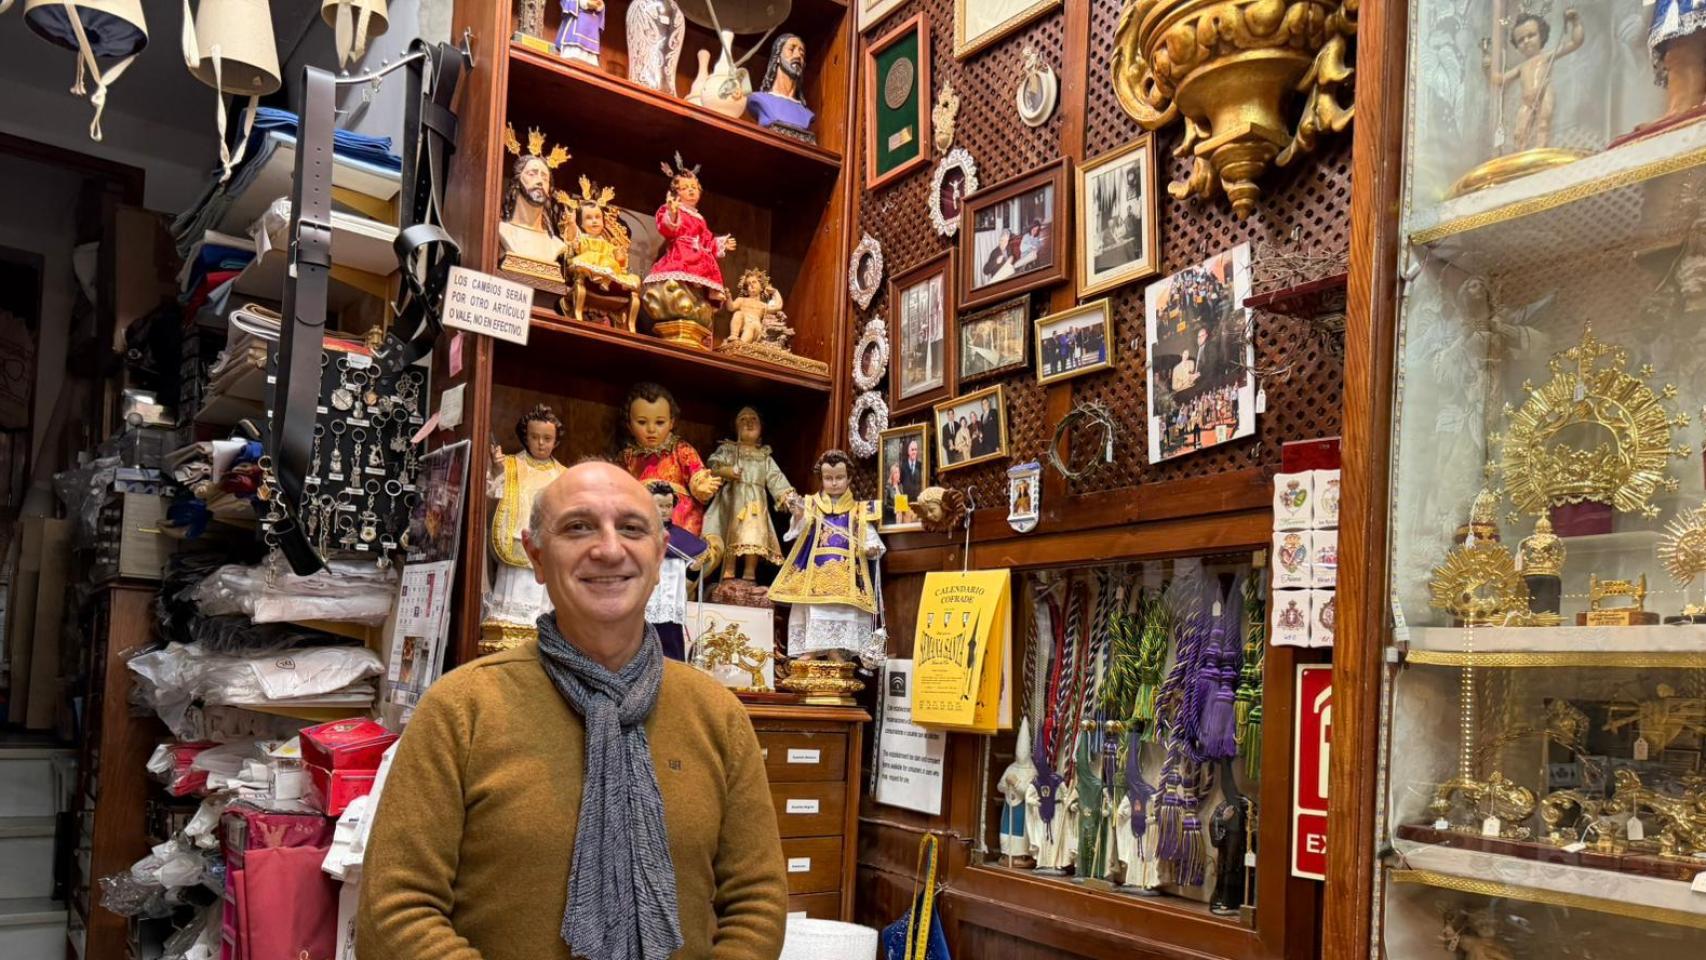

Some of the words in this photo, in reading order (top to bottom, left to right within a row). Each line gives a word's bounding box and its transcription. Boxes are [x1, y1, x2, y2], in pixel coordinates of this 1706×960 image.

[454, 275, 468, 286] LOS
[471, 279, 501, 296] CAMBIOS
[506, 289, 527, 304] SERÁN
[452, 291, 466, 304] POR
[470, 296, 489, 310] OTRO
[492, 302, 525, 320] ARTÍCULO
[449, 308, 455, 318] O
[455, 309, 472, 325] VALE,
[473, 315, 483, 326] NO
[483, 316, 492, 328] EN
[493, 320, 522, 336] EFECTIVO.
[935, 585, 985, 596] CALENDARIO
[941, 595, 975, 604] COFRADE
